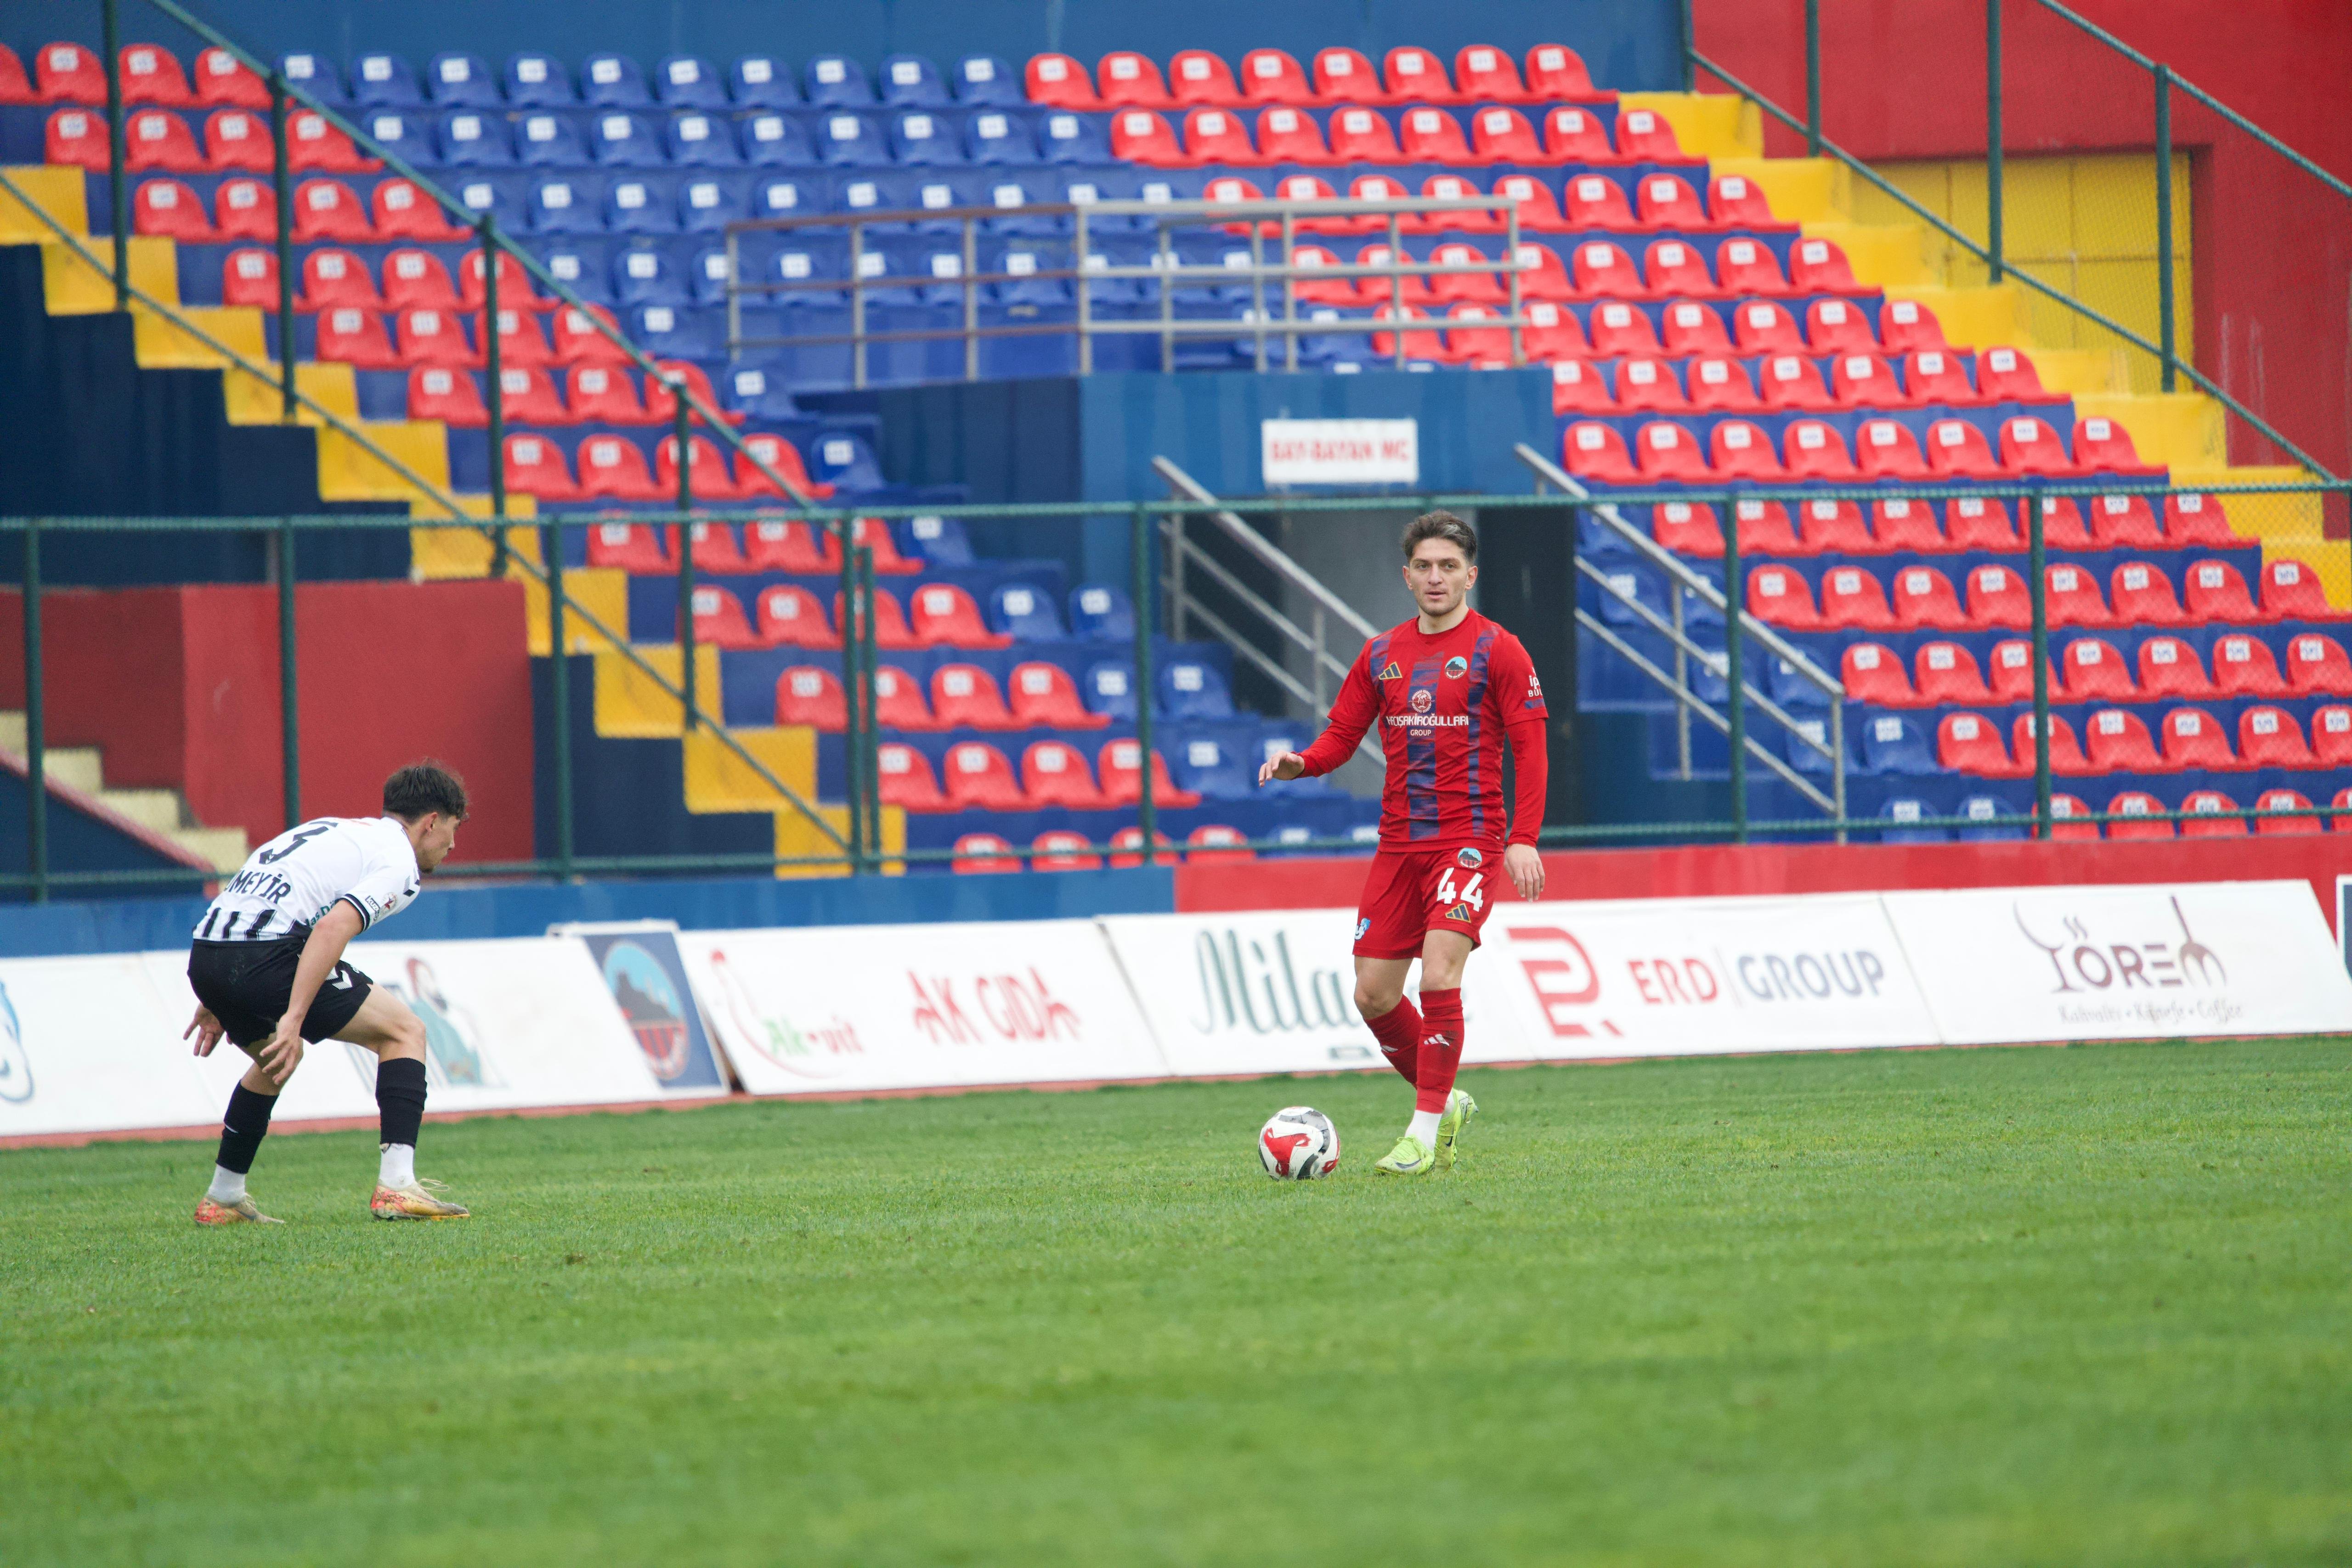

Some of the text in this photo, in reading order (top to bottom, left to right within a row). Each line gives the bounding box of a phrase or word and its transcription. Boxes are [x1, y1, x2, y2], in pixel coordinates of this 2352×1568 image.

[1386, 713, 1469, 728] HACIŞAKİROĞULLARI
[224, 869, 291, 904] MEYİR
[1437, 868, 1484, 912] 44
[1189, 929, 1363, 1034] Mila
[1627, 949, 1885, 1005] ERD GROUP
[905, 969, 984, 1045] AK
